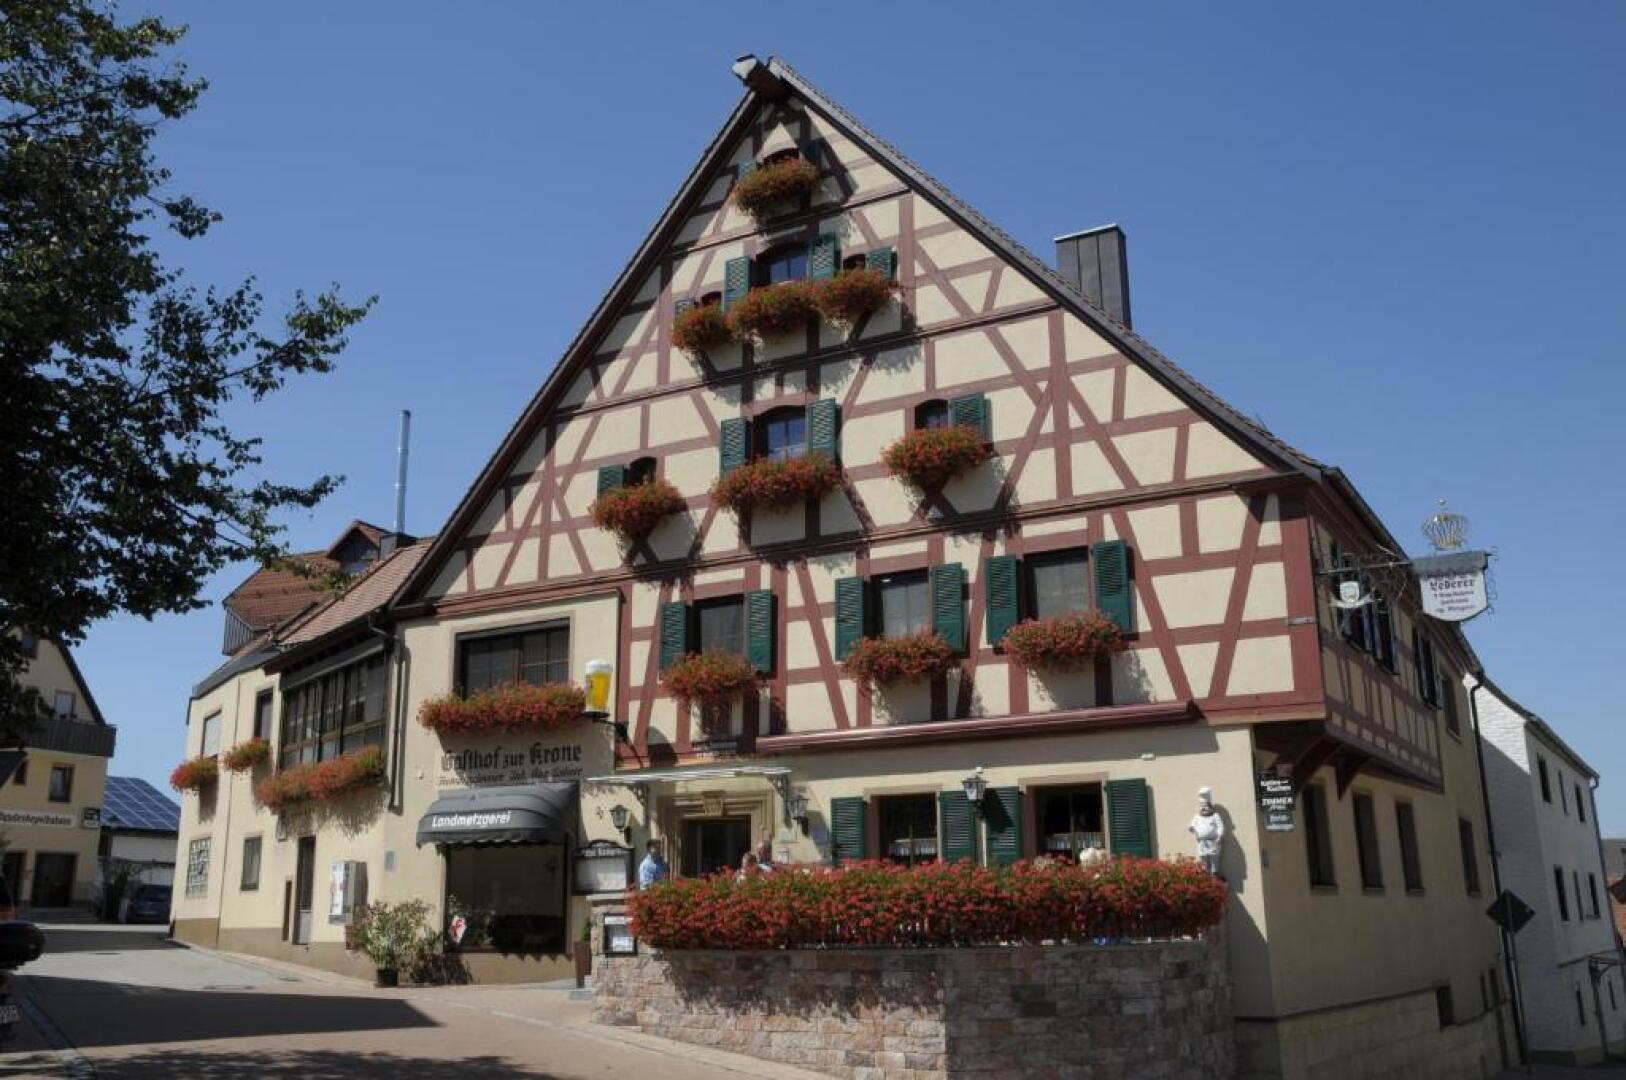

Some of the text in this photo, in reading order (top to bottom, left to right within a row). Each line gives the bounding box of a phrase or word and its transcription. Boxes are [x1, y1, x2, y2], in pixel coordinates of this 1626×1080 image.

[502, 752, 525, 769] zur
[529, 742, 582, 765] Krone
[432, 810, 512, 828] Landmetzgerei
